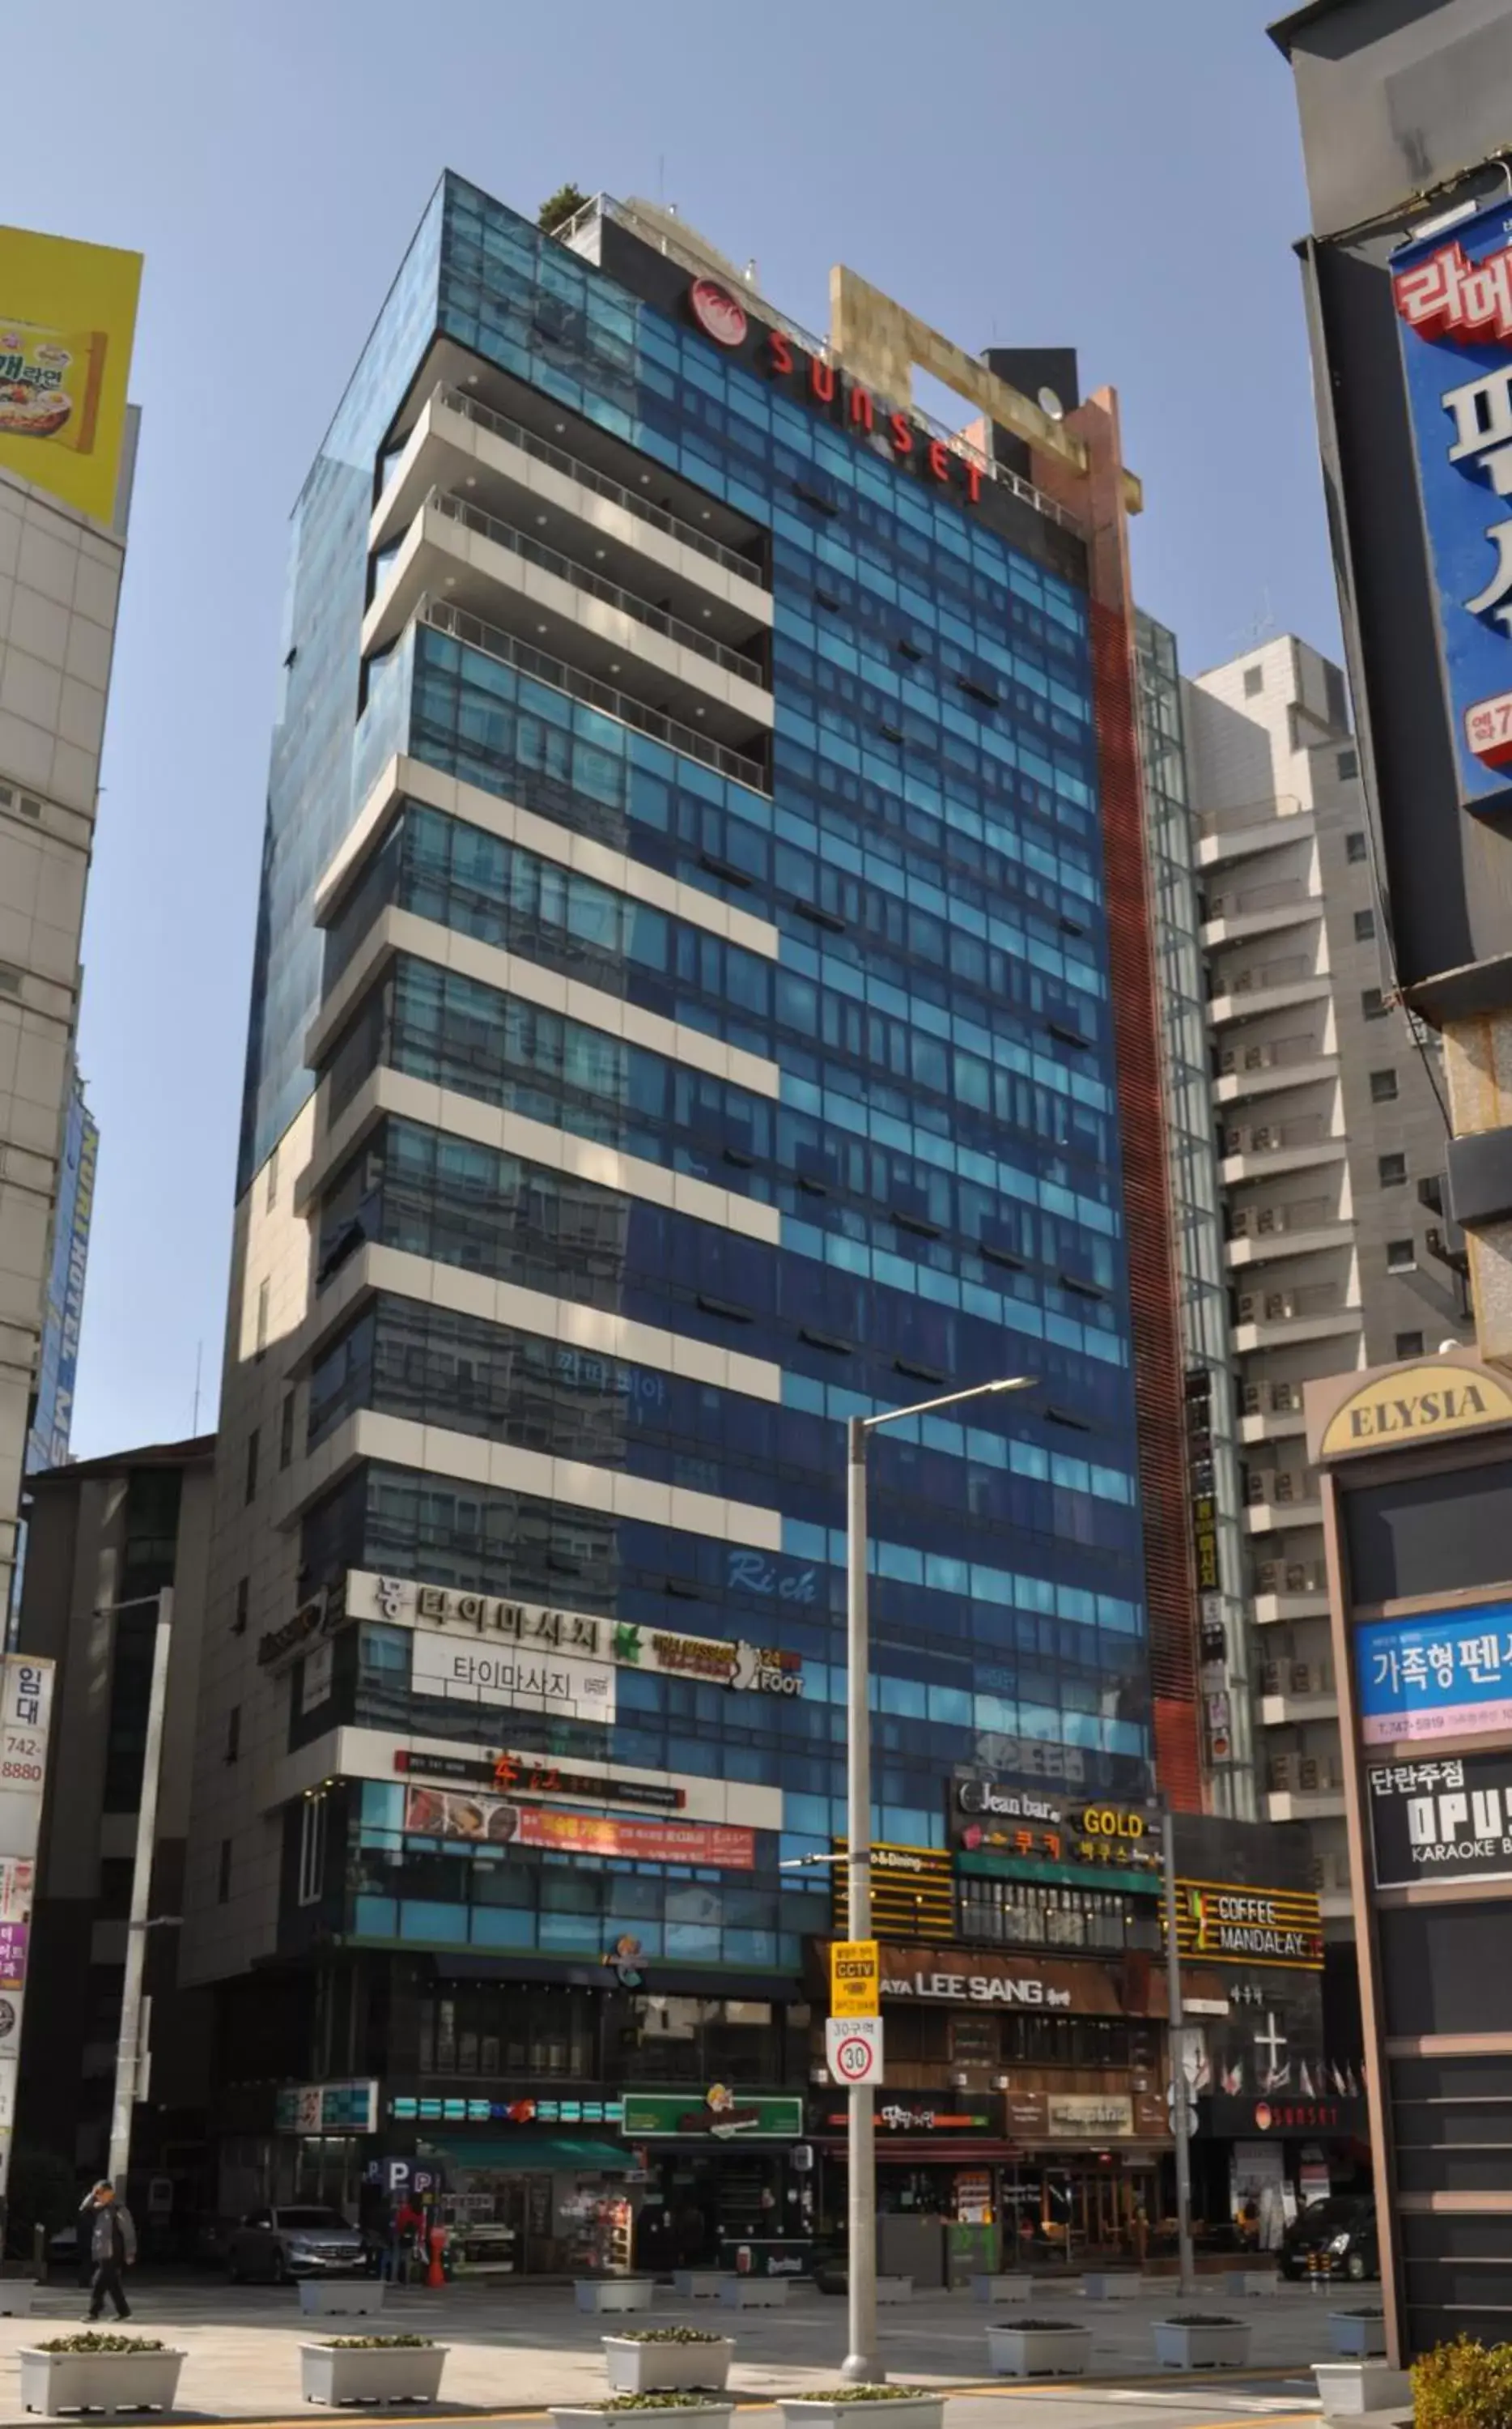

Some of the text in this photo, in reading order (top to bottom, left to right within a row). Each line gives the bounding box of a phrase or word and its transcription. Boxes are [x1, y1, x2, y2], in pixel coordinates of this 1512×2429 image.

[769, 329, 983, 504] SUNSET
[1349, 1384, 1489, 1440] ELYSIA
[728, 1551, 816, 1602] Rich
[453, 1657, 571, 1699] 타이마사지
[1373, 1642, 1454, 1694] 가족형
[16, 1667, 41, 1725] 임대
[762, 1673, 804, 1695] FOOT
[2, 1761, 41, 1781] 8880
[1371, 1759, 1464, 1796] 단란주점
[980, 1782, 1020, 1814] Jean
[1084, 1809, 1144, 1838] GOLD
[1407, 1788, 1512, 1845] OPU
[1412, 1840, 1495, 1861] KARAOKE
[1219, 1896, 1276, 1924] COFFEE
[1220, 1927, 1306, 1956] MANDALAY
[838, 1963, 873, 1976] CCTV
[844, 2046, 865, 2069] 30
[389, 2162, 410, 2190] P
